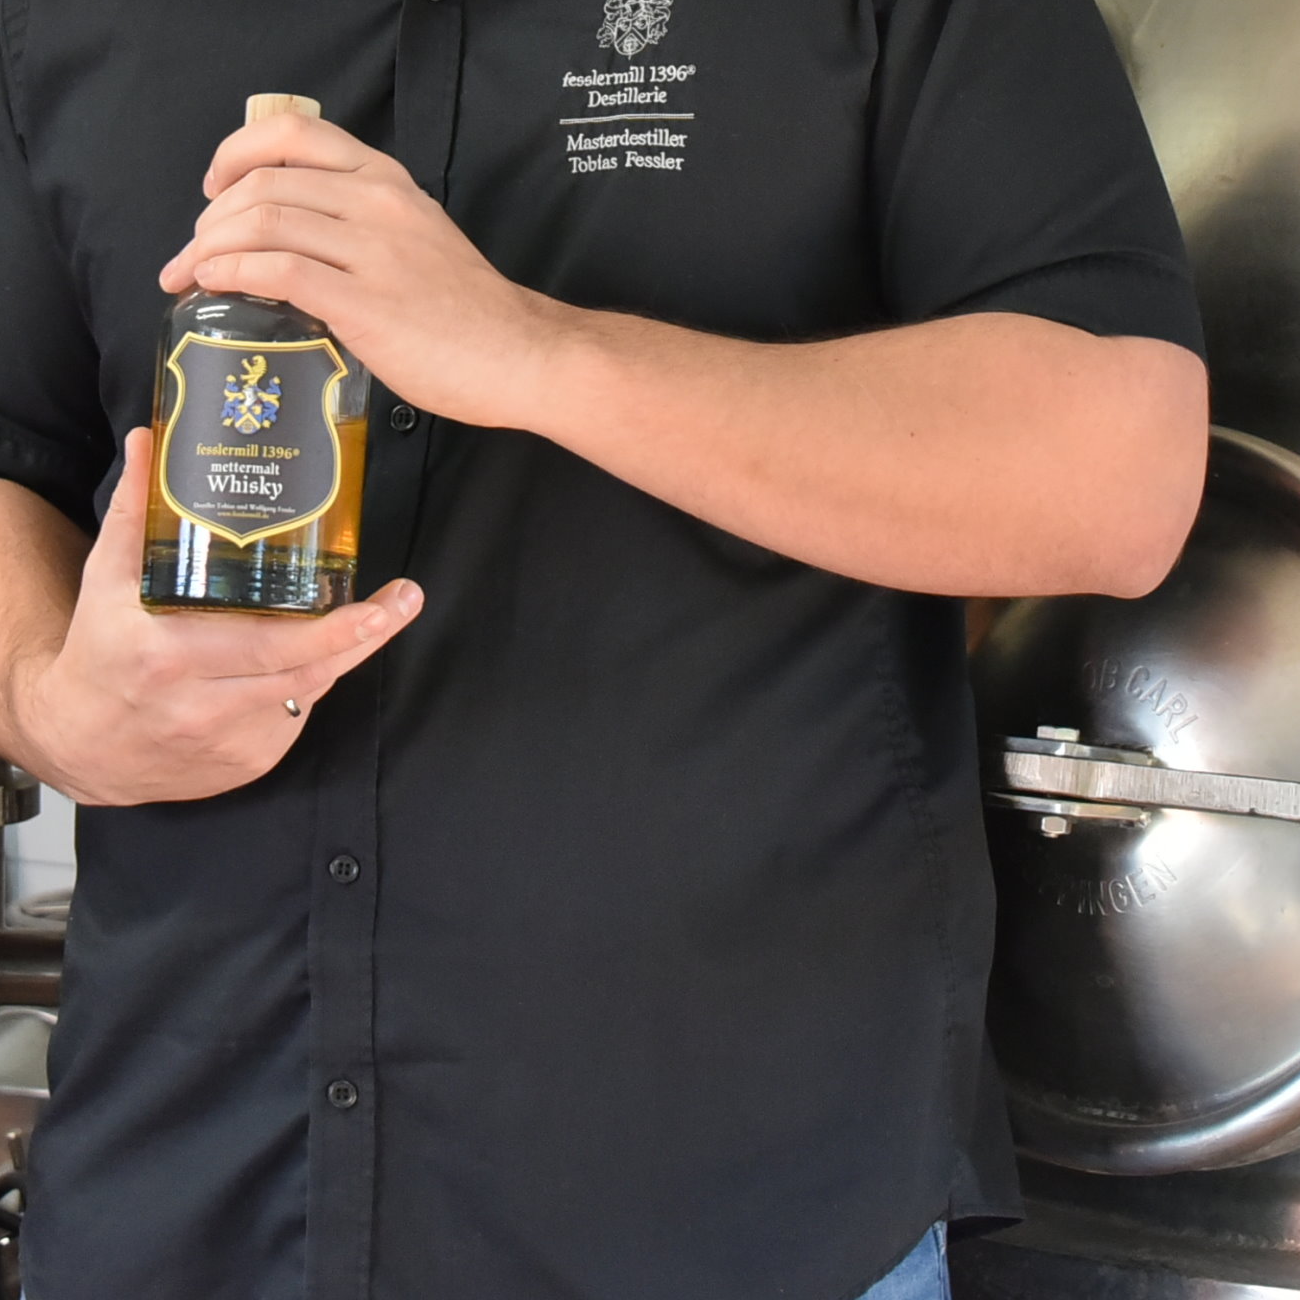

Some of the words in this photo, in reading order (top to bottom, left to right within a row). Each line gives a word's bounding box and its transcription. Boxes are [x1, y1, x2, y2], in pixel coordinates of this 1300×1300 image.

[562, 66, 645, 88] fesslermill
[587, 86, 667, 108] Destillerie
[566, 128, 688, 152] Masterdestiller
[568, 154, 618, 174] Tobias
[624, 150, 685, 171] Fessler
[196, 442, 259, 458] fesslermill
[210, 461, 280, 476] mettermalt
[207, 474, 283, 501] Whisky
[1125, 664, 1199, 745] CARL
